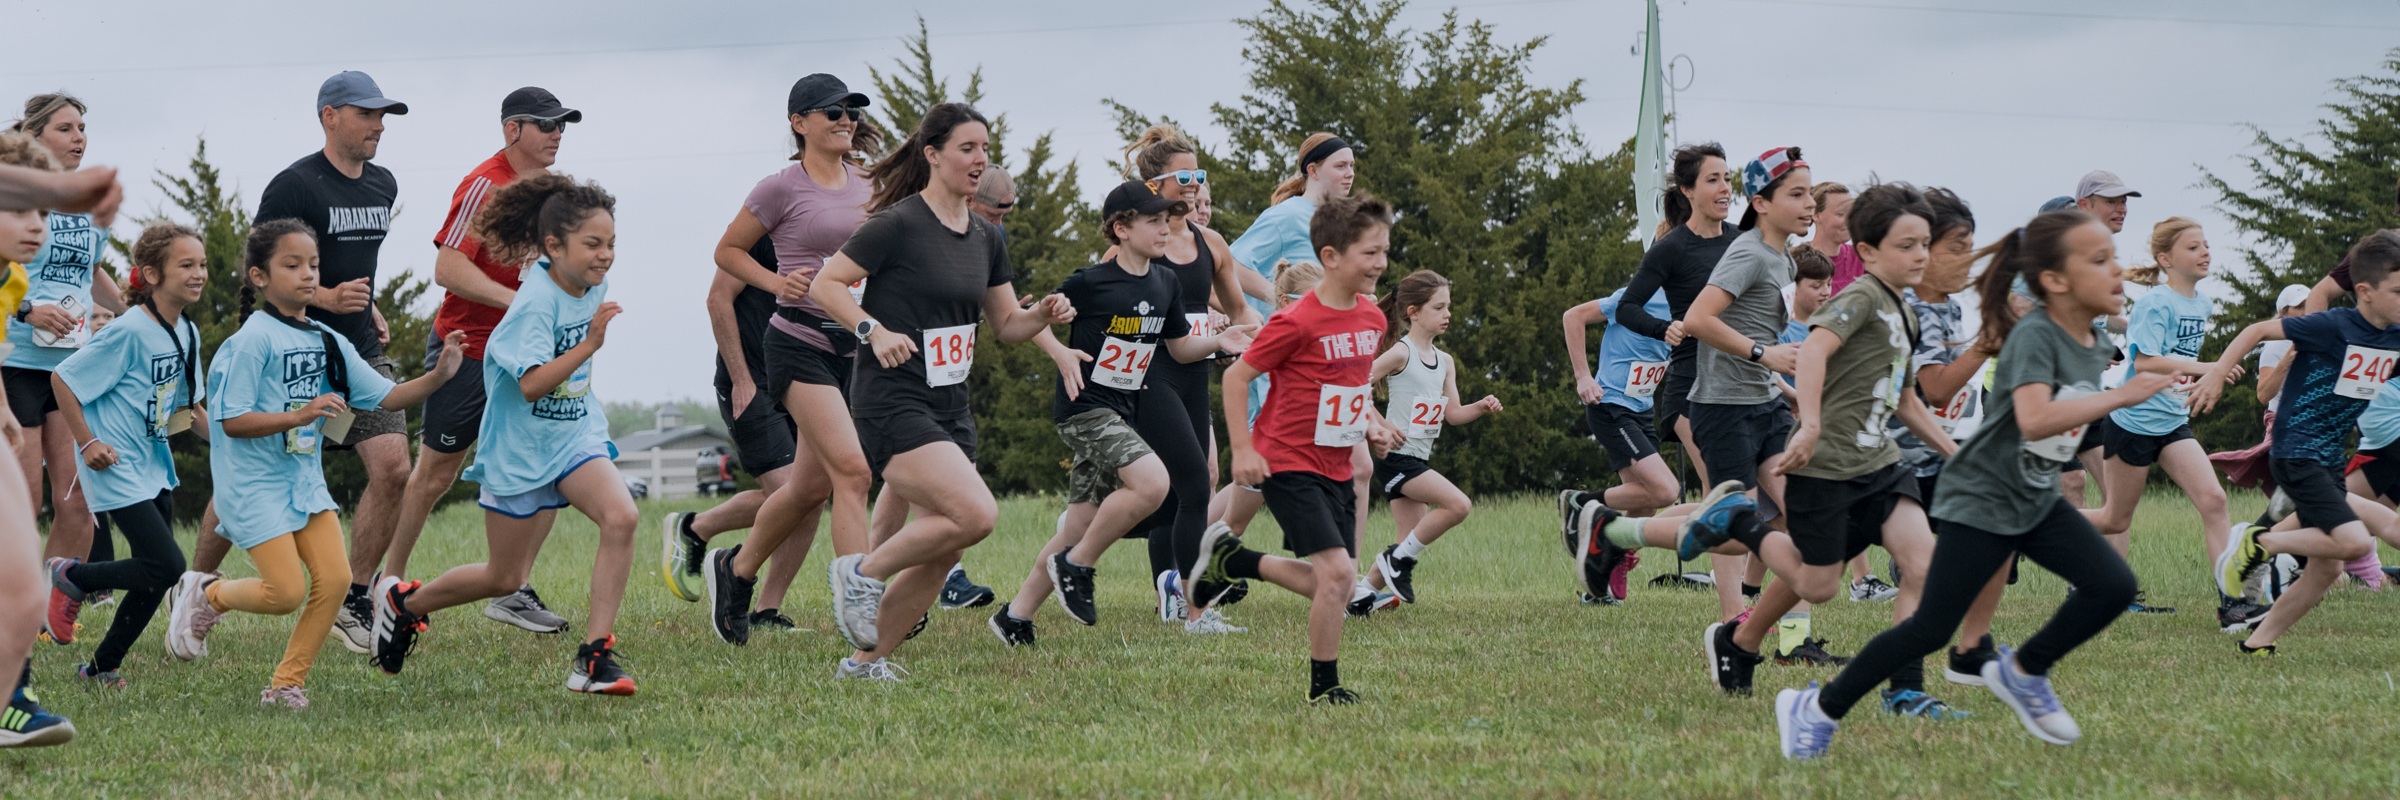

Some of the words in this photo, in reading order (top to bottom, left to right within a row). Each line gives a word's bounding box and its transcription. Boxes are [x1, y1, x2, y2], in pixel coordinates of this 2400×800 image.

[52, 214, 77, 230] IT'S
[79, 217, 89, 228] A
[56, 231, 89, 249] GREAT
[52, 248, 74, 263] DAY
[75, 252, 90, 266] TO
[929, 331, 975, 367] 186
[1098, 344, 1152, 374] 214
[1319, 333, 1355, 360] THE
[285, 353, 318, 381] IT'S
[1631, 365, 1666, 386] 190
[2342, 353, 2393, 383] 240
[290, 377, 322, 398] GREA
[1323, 394, 1371, 427] 19
